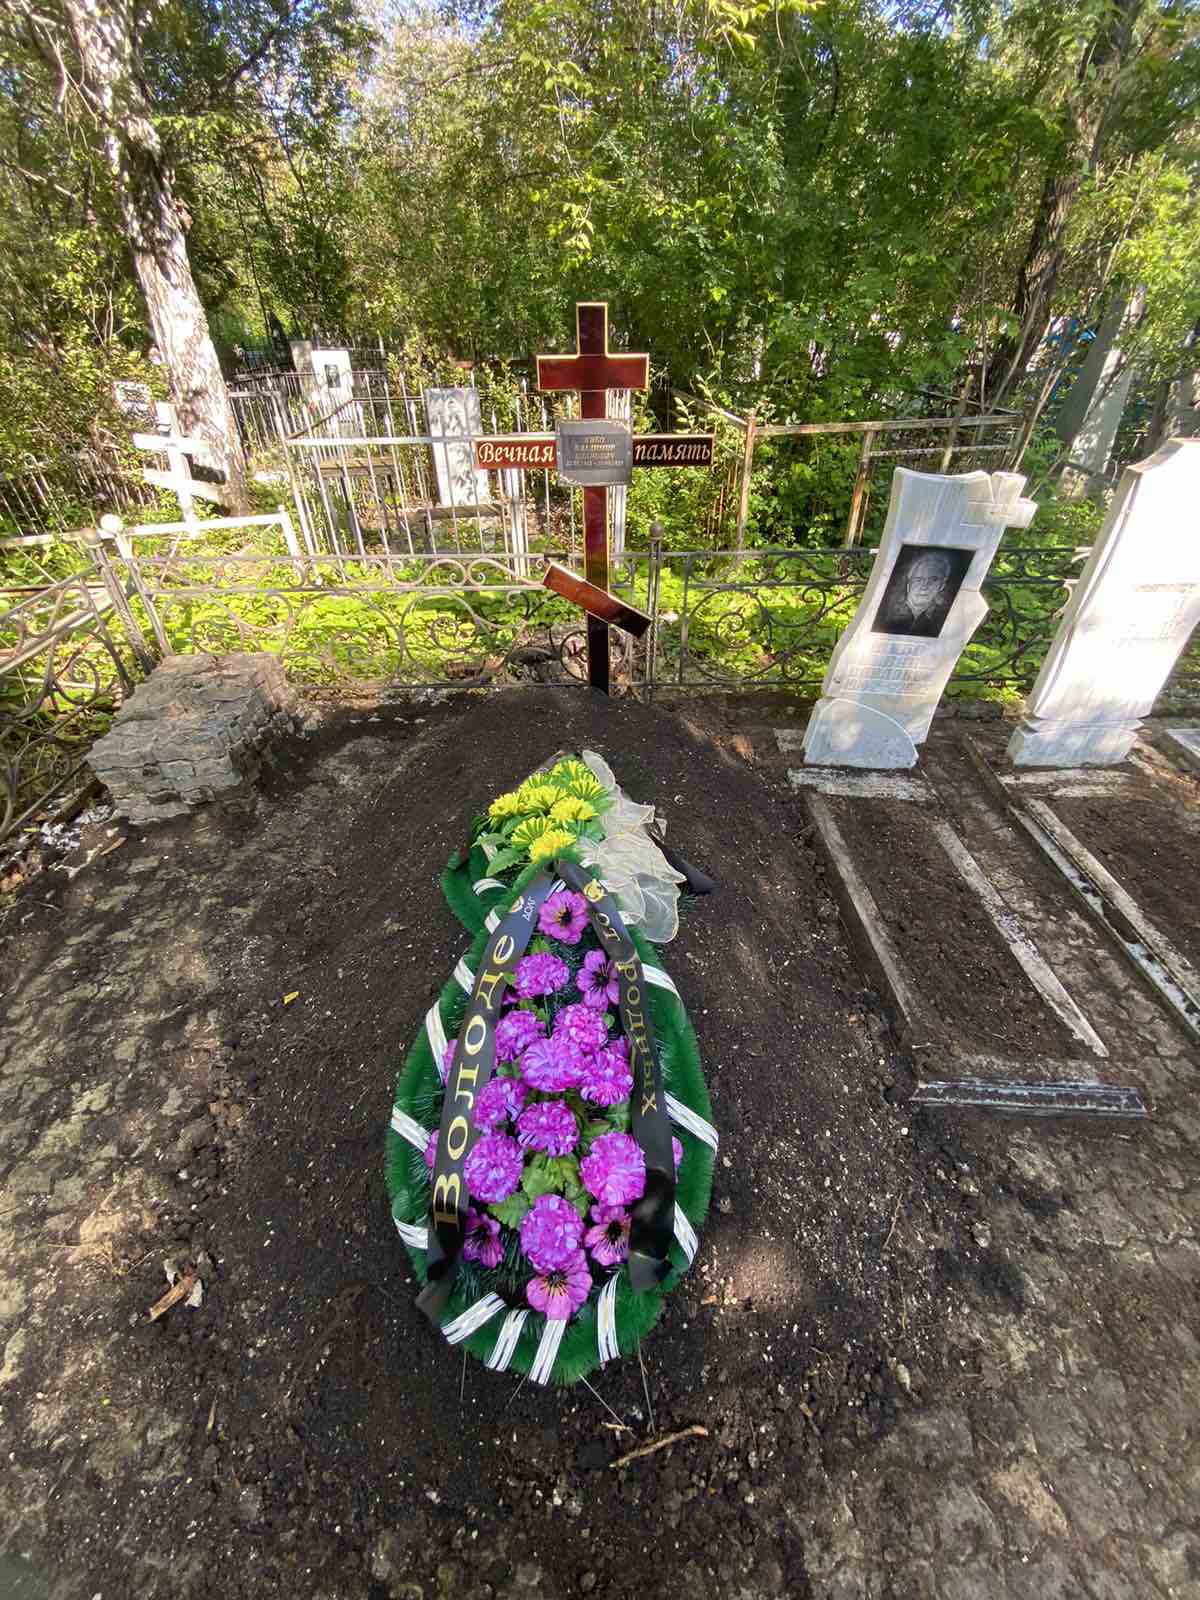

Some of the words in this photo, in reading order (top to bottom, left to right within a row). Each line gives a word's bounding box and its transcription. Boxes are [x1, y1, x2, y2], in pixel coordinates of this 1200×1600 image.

[478, 443, 555, 464] Вечная
[634, 443, 711, 462] память
[614, 961, 658, 1117] родных
